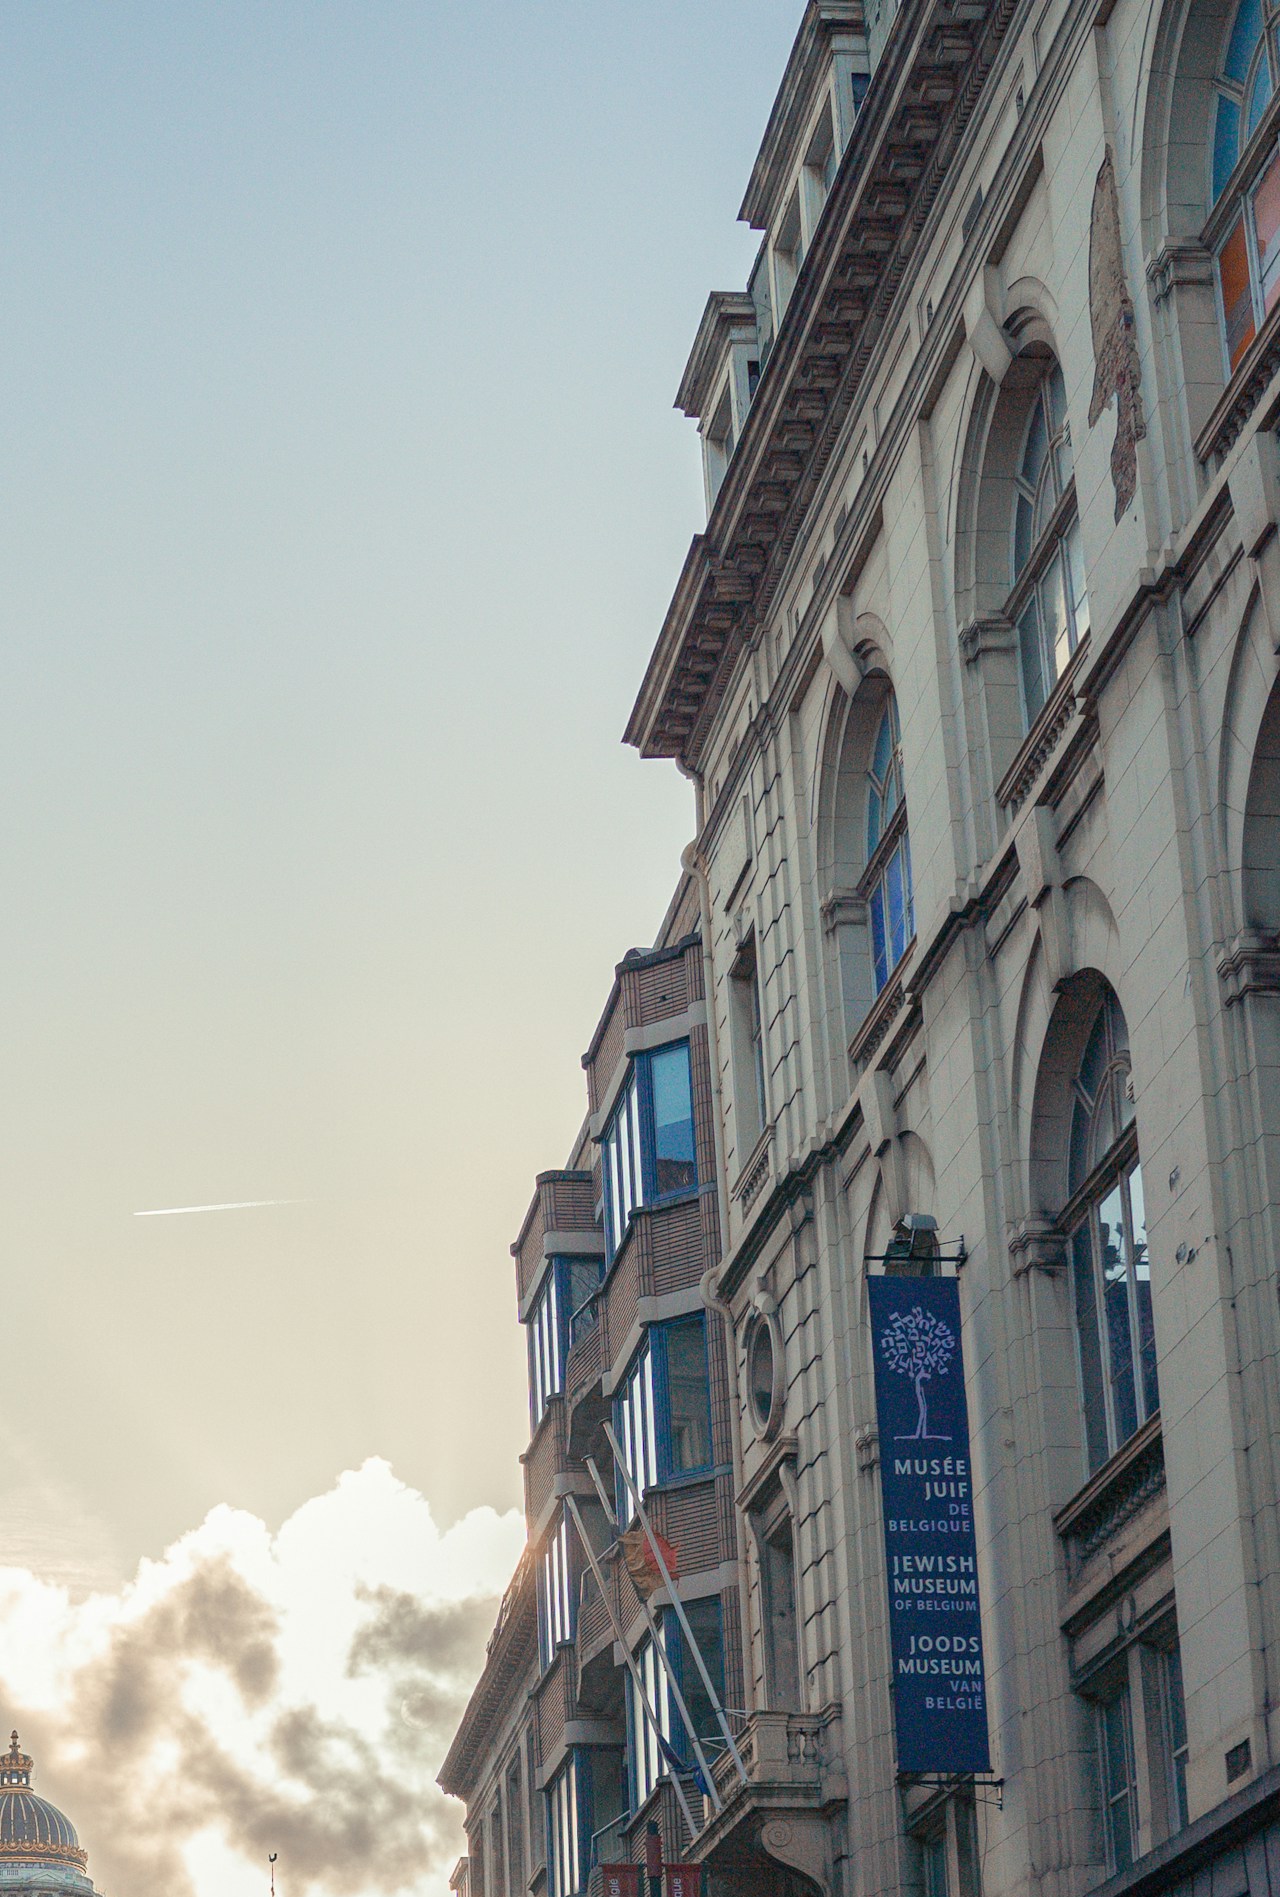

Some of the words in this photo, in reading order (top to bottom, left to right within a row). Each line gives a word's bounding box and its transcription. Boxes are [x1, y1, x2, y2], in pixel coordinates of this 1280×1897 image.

[894, 1456, 967, 1476] MUSÉE
[925, 1481, 968, 1501] JUIF
[949, 1503, 969, 1516] DE
[888, 1520, 971, 1534] BELGIQUE
[893, 1555, 974, 1576] JEWISH
[894, 1578, 976, 1595] MUSEUM
[895, 1599, 912, 1611] OF
[917, 1599, 977, 1612] BELGIUM
[909, 1635, 980, 1655] JOODS
[898, 1658, 982, 1675] MUSEUM
[950, 1680, 982, 1693] VAN
[925, 1694, 983, 1710] BELGIË
